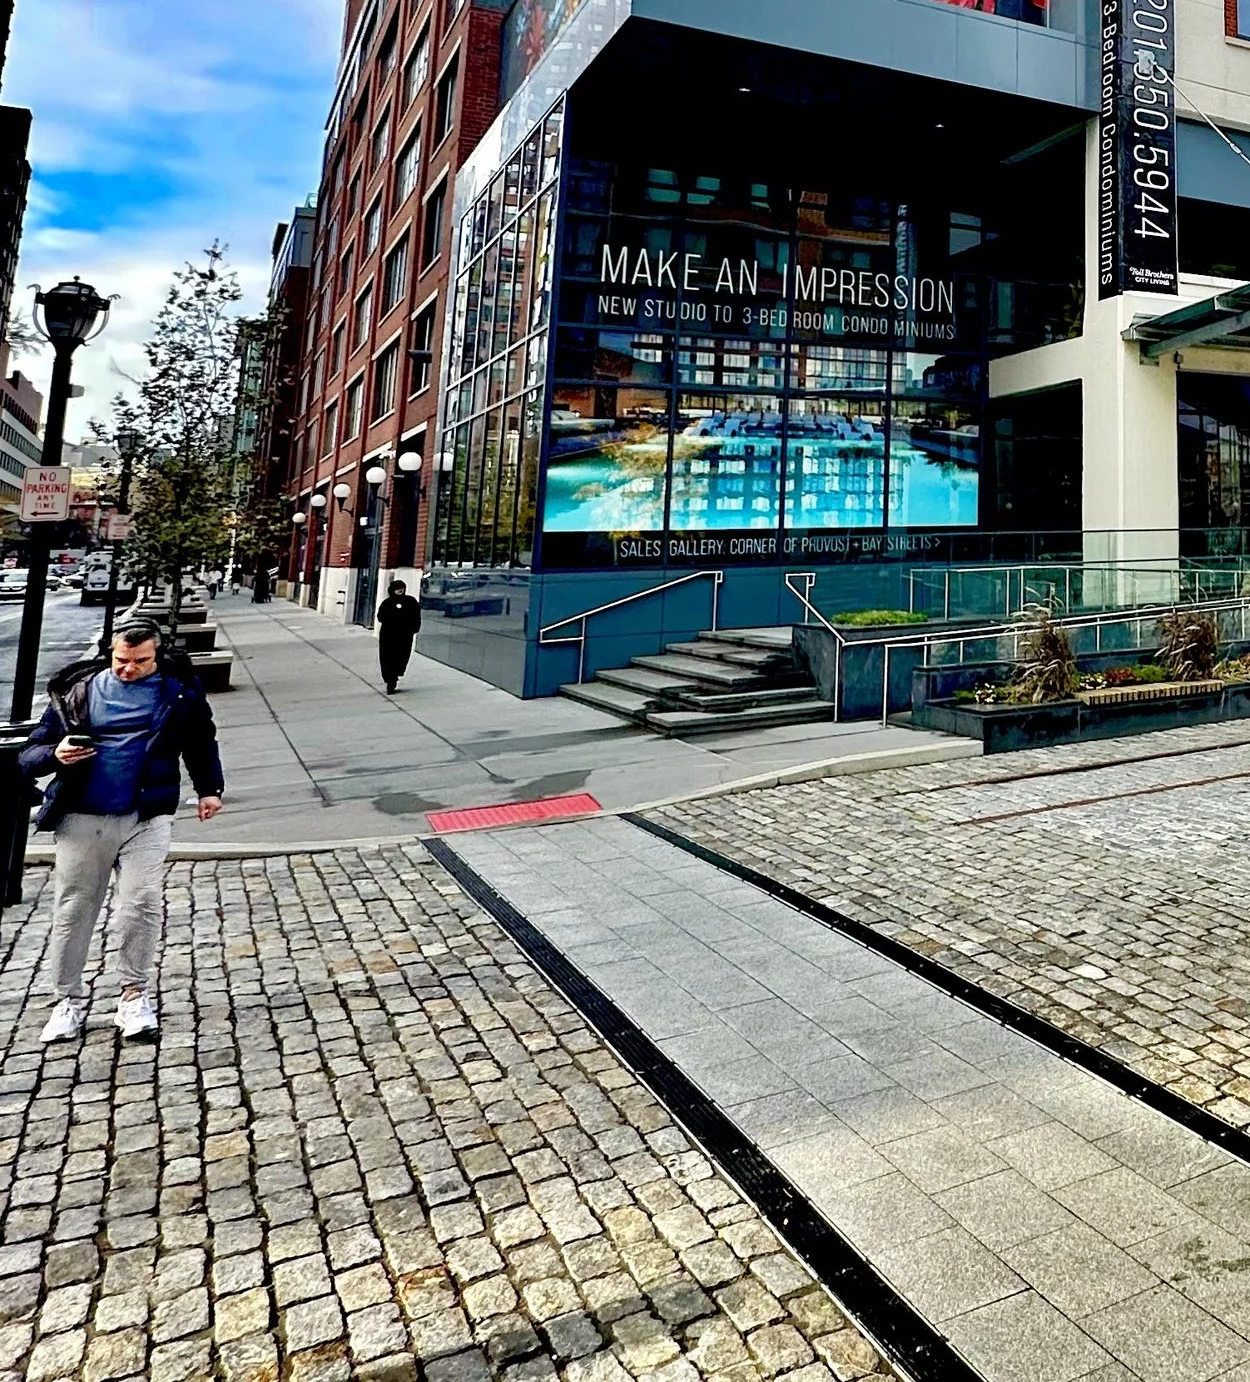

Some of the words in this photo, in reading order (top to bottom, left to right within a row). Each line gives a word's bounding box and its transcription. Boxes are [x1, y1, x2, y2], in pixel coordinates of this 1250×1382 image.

[1102, 0, 1118, 118] 3-Bedroom
[1101, 122, 1117, 286] Condominiums
[600, 243, 702, 291] MAKE
[715, 257, 758, 296] AN
[597, 295, 637, 316] NEW
[644, 298, 707, 321] STUDIO
[713, 304, 733, 323] TO
[26, 483, 67, 494] PARKING
[39, 471, 57, 482] NO
[620, 540, 662, 558] SALES
[729, 538, 777, 555] CORNER
[783, 537, 798, 553] OF
[861, 536, 883, 551] BAY
